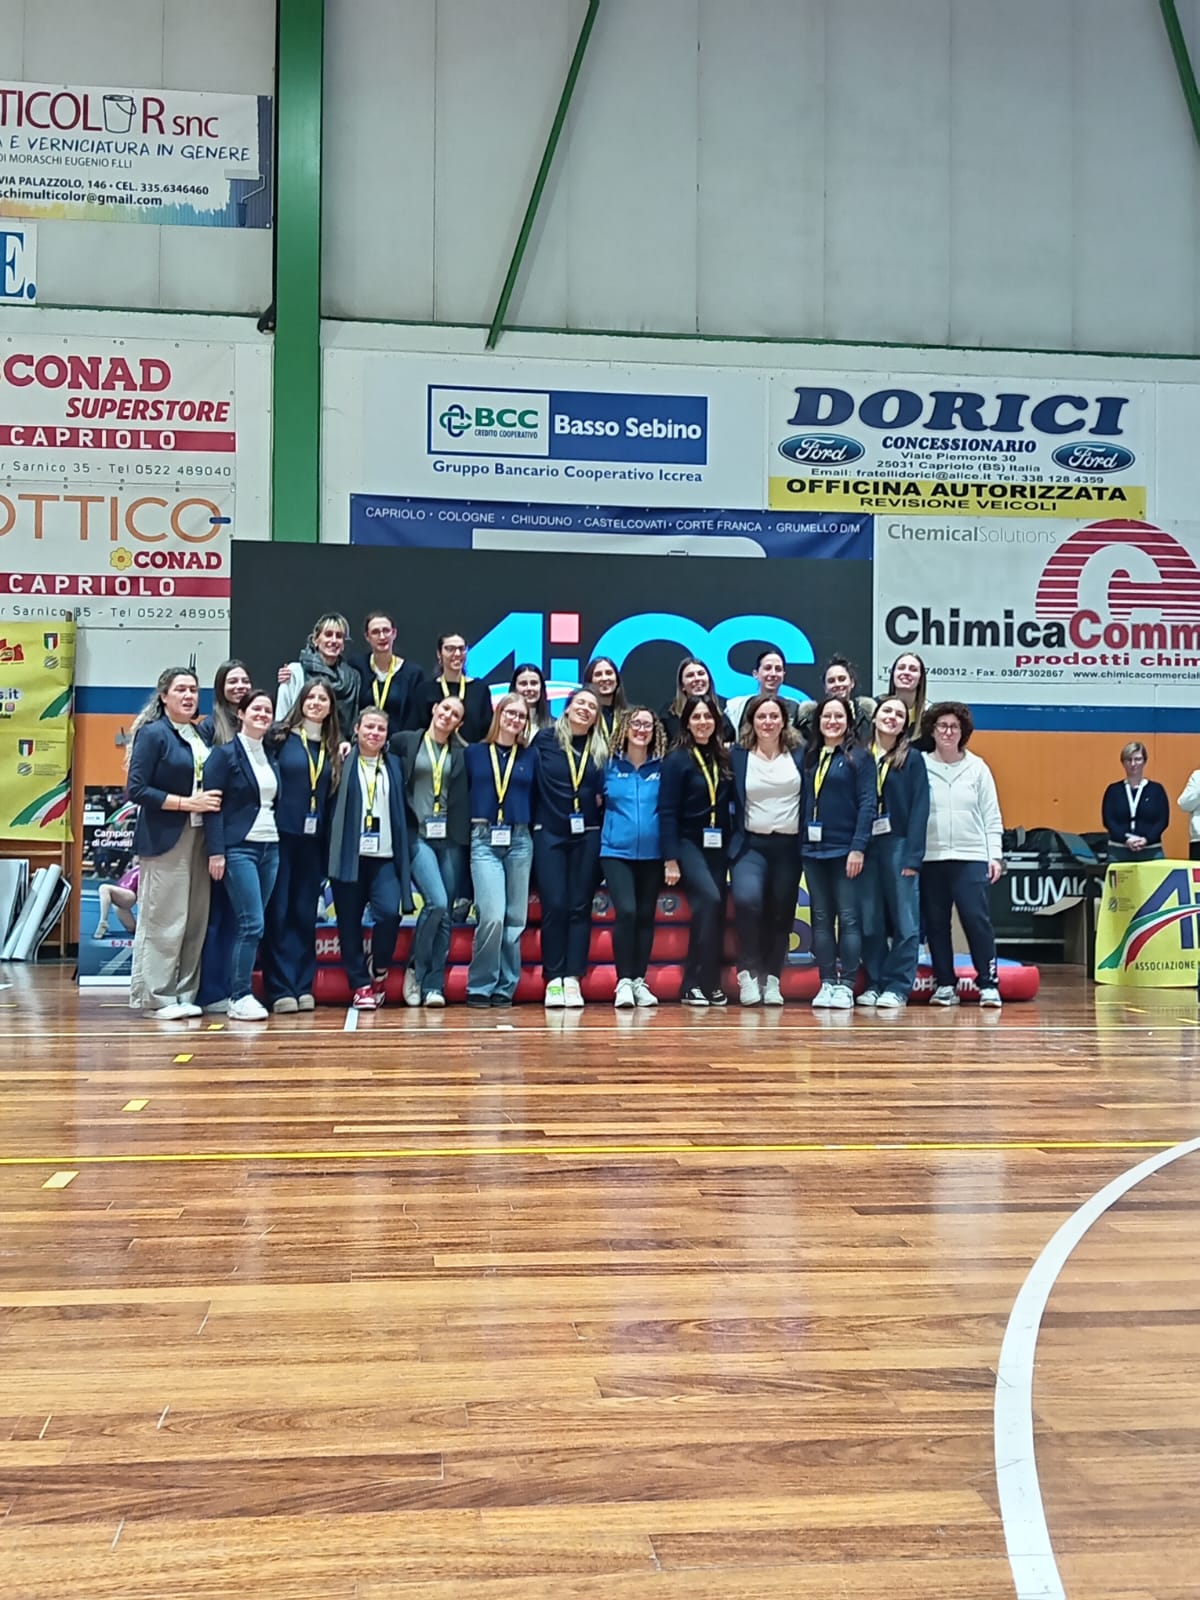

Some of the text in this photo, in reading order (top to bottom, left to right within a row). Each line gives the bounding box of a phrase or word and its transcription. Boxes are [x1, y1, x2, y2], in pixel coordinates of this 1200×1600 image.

[172, 114, 219, 138] snc
[10, 135, 20, 149] E
[27, 136, 150, 157] VERNICIATURA
[157, 143, 174, 156] IN
[181, 145, 250, 161] GENERE
[9, 153, 62, 165] MORASCHI
[65, 156, 110, 168] EUGENIO
[19, 176, 85, 189] PALAZZOLO,
[88, 180, 107, 189] 146
[116, 181, 138, 192] CEL.
[140, 183, 209, 195] 335.6346460
[4, 354, 171, 391] CONAD
[66, 397, 230, 422] SUPERSTORE
[787, 387, 1129, 436] DORICI
[475, 407, 702, 439] BCC Basso Sebino
[10, 427, 176, 450] CAPRIOLO
[474, 429, 538, 439] CREDITO COOPERATIVO
[795, 437, 849, 461] Ford
[882, 436, 1037, 453] CONCESSIONARIO
[877, 460, 1041, 472] 25031 Capriolo (BS) Italia
[901, 452, 933, 460] Viale
[937, 452, 998, 462] Piemonte
[1068, 446, 1119, 469] Ford
[13, 461, 66, 472] Sarnico
[73, 463, 90, 473] 35
[109, 464, 130, 473] Tel
[135, 464, 171, 475] 0522
[177, 466, 231, 477] 489040
[433, 460, 703, 482] Gruppo Bancario Cooperativo Iccrea
[811, 468, 852, 477] Email:
[857, 469, 992, 481] fratellidorici@alice.it
[997, 474, 1018, 482] Tel.
[1050, 475, 1070, 483] 128
[786, 478, 1127, 501] OFFICINA AUTORIZZATA
[861, 497, 1057, 511] REVISIONE VEICOLI
[366, 507, 861, 534] CAPRIOLO COLOGNE CHIUDUNO CASTELCOVATI CORTE FRANCA GRUMELLO D/M
[888, 523, 1057, 544] ChemicalSolutions
[134, 551, 222, 570] CONAD
[9, 575, 175, 595] CAPRIOLO
[13, 605, 67, 616] Sarnico
[111, 607, 131, 617] Tel
[137, 608, 173, 618] 0522
[1016, 652, 1130, 668] prodotti
[977, 669, 998, 677] Fax.
[1001, 669, 1064, 678] 030/7302867
[1135, 961, 1196, 971] ASSOCIAZIONE
